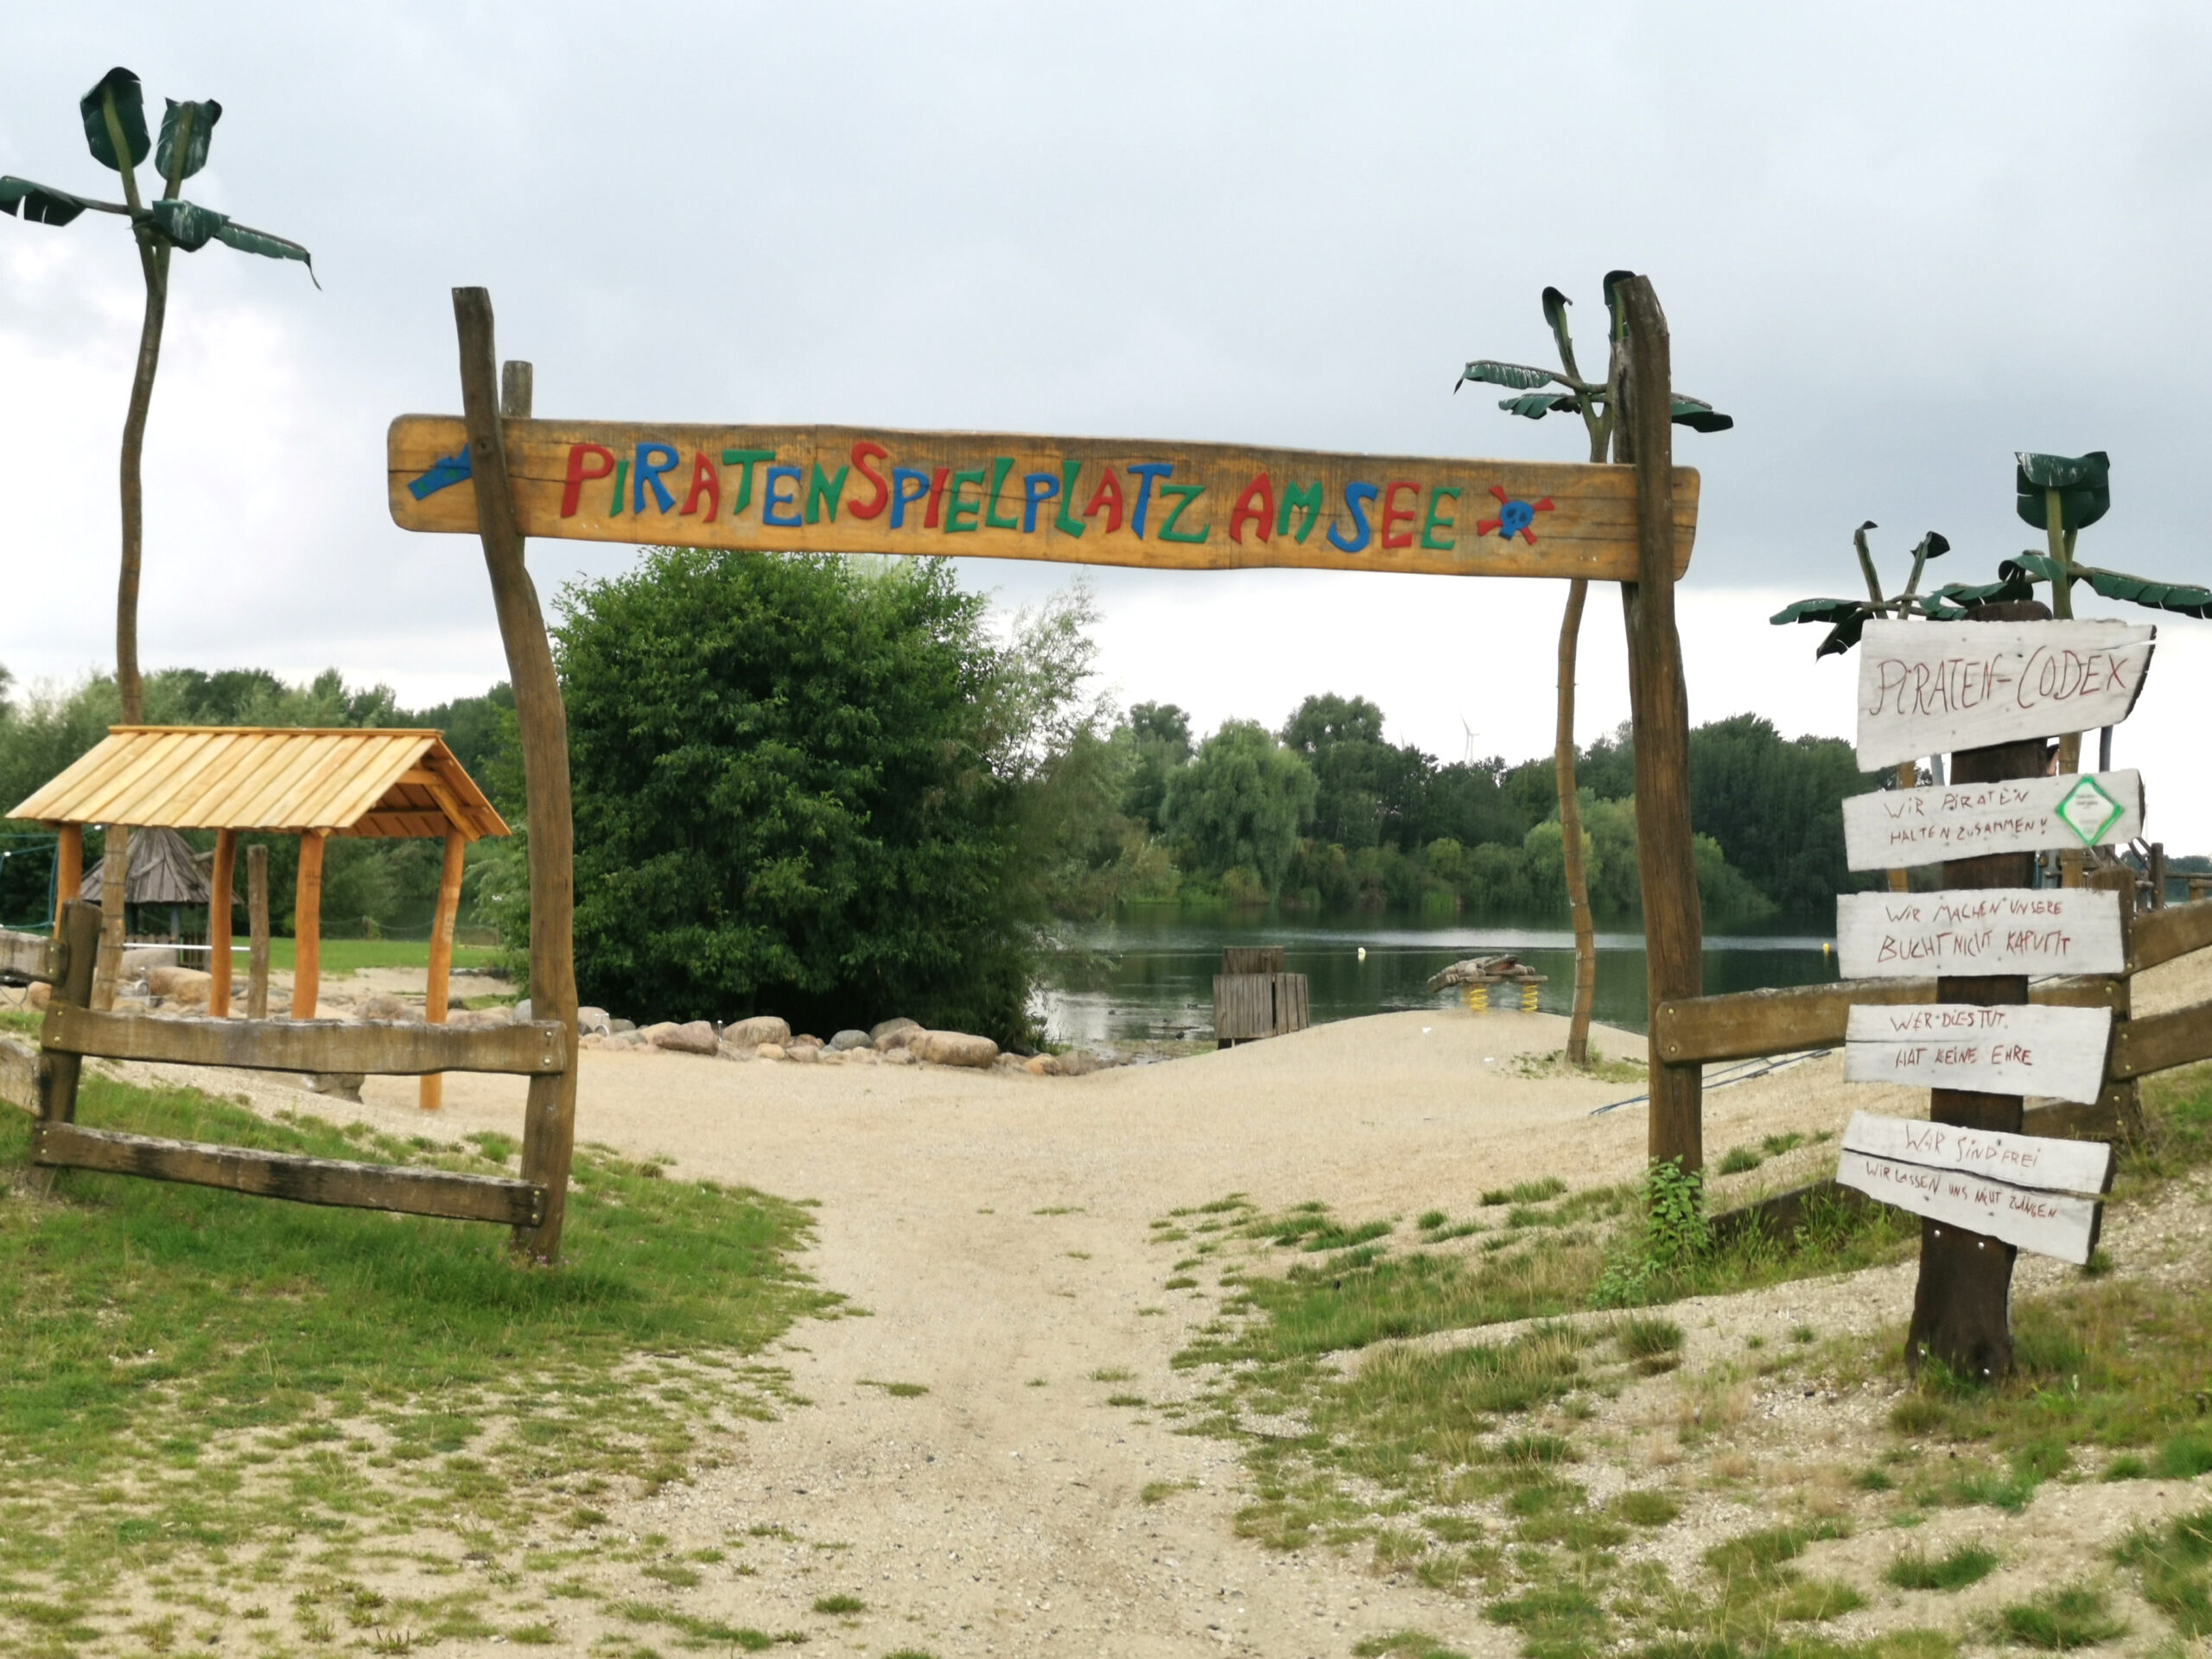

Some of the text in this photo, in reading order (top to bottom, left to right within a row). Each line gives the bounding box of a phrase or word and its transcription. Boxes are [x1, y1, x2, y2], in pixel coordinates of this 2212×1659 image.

[1230, 473, 1323, 545] AM
[1327, 480, 1461, 550] SEE
[1890, 825, 1950, 845] HALTEN
[1933, 900, 2002, 924] MACHEN
[2009, 899, 2063, 915] UNSERE
[1878, 931, 1953, 963] BUCHT
[1890, 1012, 1932, 1032] WER
[1895, 1047, 1927, 1069] HAT
[1991, 1044, 2033, 1066] EHRE
[1895, 1168, 1942, 1194] LASSEN
[1948, 1182, 1968, 1200] UNS
